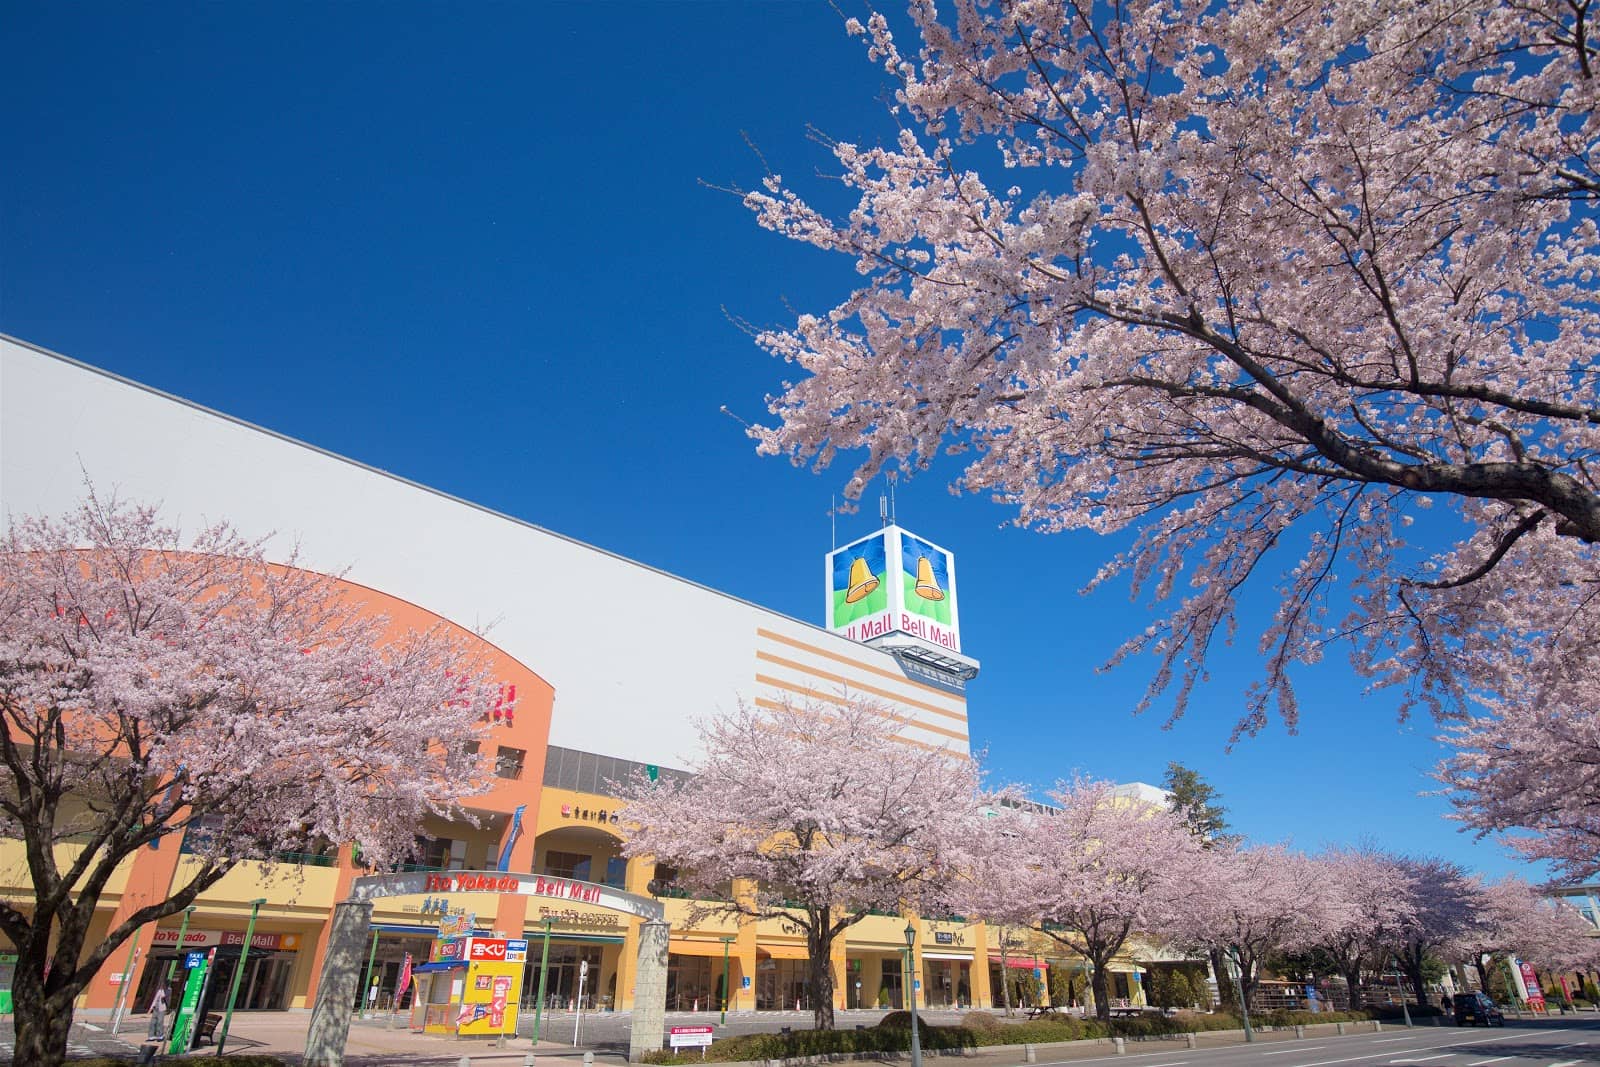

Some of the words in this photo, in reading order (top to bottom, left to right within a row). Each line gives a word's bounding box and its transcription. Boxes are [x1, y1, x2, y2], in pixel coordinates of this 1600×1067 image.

[861, 613, 892, 641] Mall
[901, 613, 927, 639] Bell
[930, 624, 957, 650] Mall
[425, 873, 452, 891] Ito
[455, 872, 519, 891] Yokado
[535, 875, 564, 897] Bell
[568, 882, 601, 903] Mall
[166, 931, 206, 943] Yoado
[227, 933, 248, 945] Bel
[250, 934, 274, 946] Mall
[472, 943, 504, 956] 宝くじ
